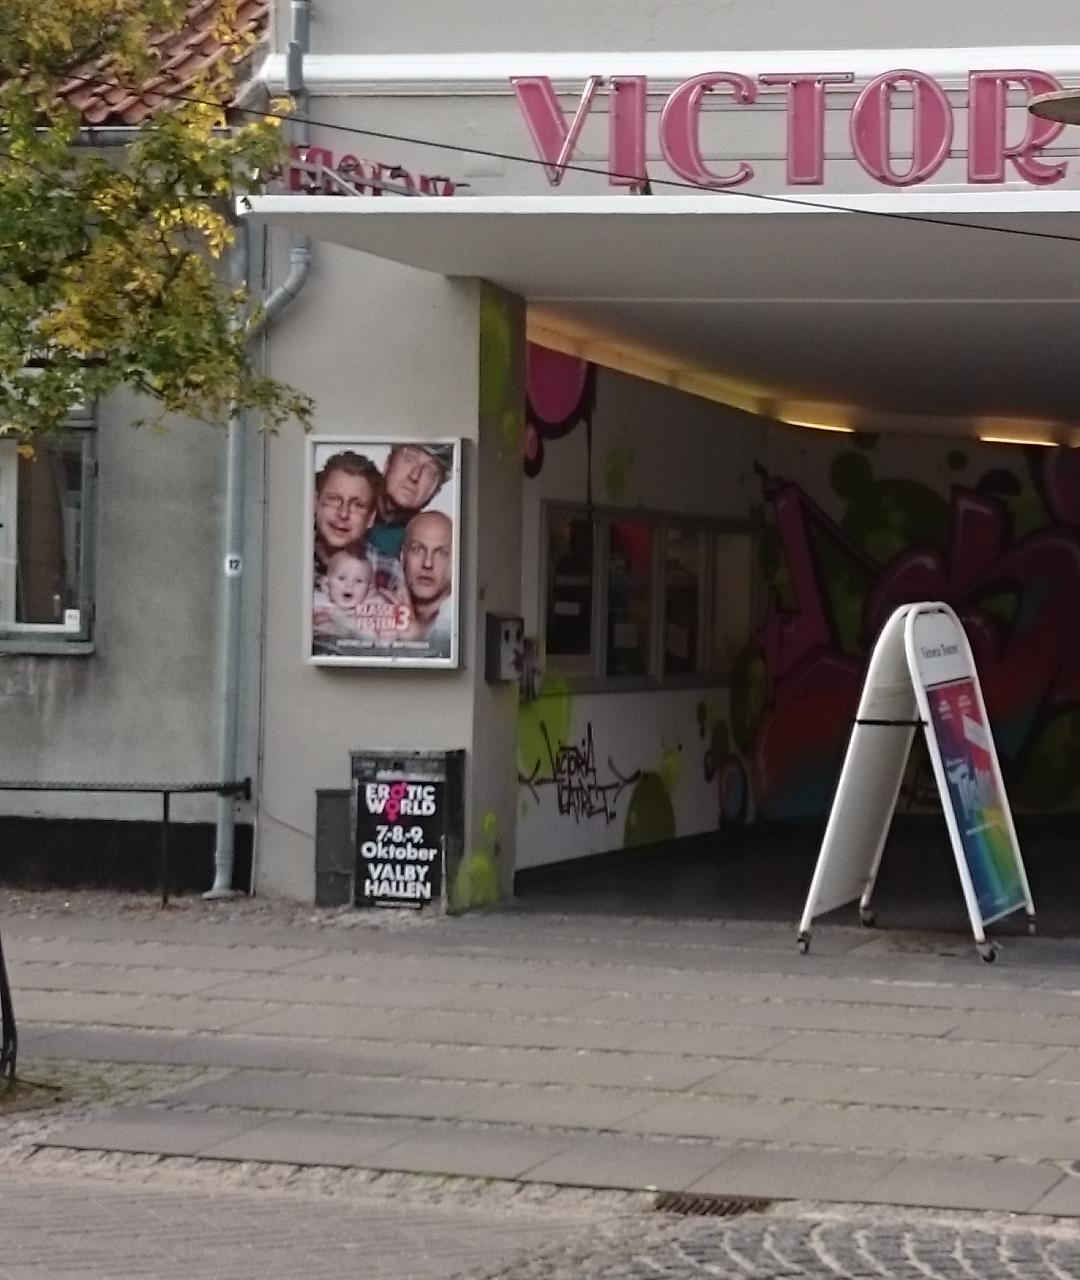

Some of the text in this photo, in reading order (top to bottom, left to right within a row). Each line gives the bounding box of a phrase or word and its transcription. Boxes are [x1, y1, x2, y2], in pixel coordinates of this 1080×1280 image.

[396, 606, 411, 631] 3
[365, 781, 435, 800] EROTIC
[366, 799, 435, 821] WORLD
[360, 841, 437, 861] Oktober
[368, 862, 429, 882] VALBY
[364, 879, 431, 899] HALLEN
